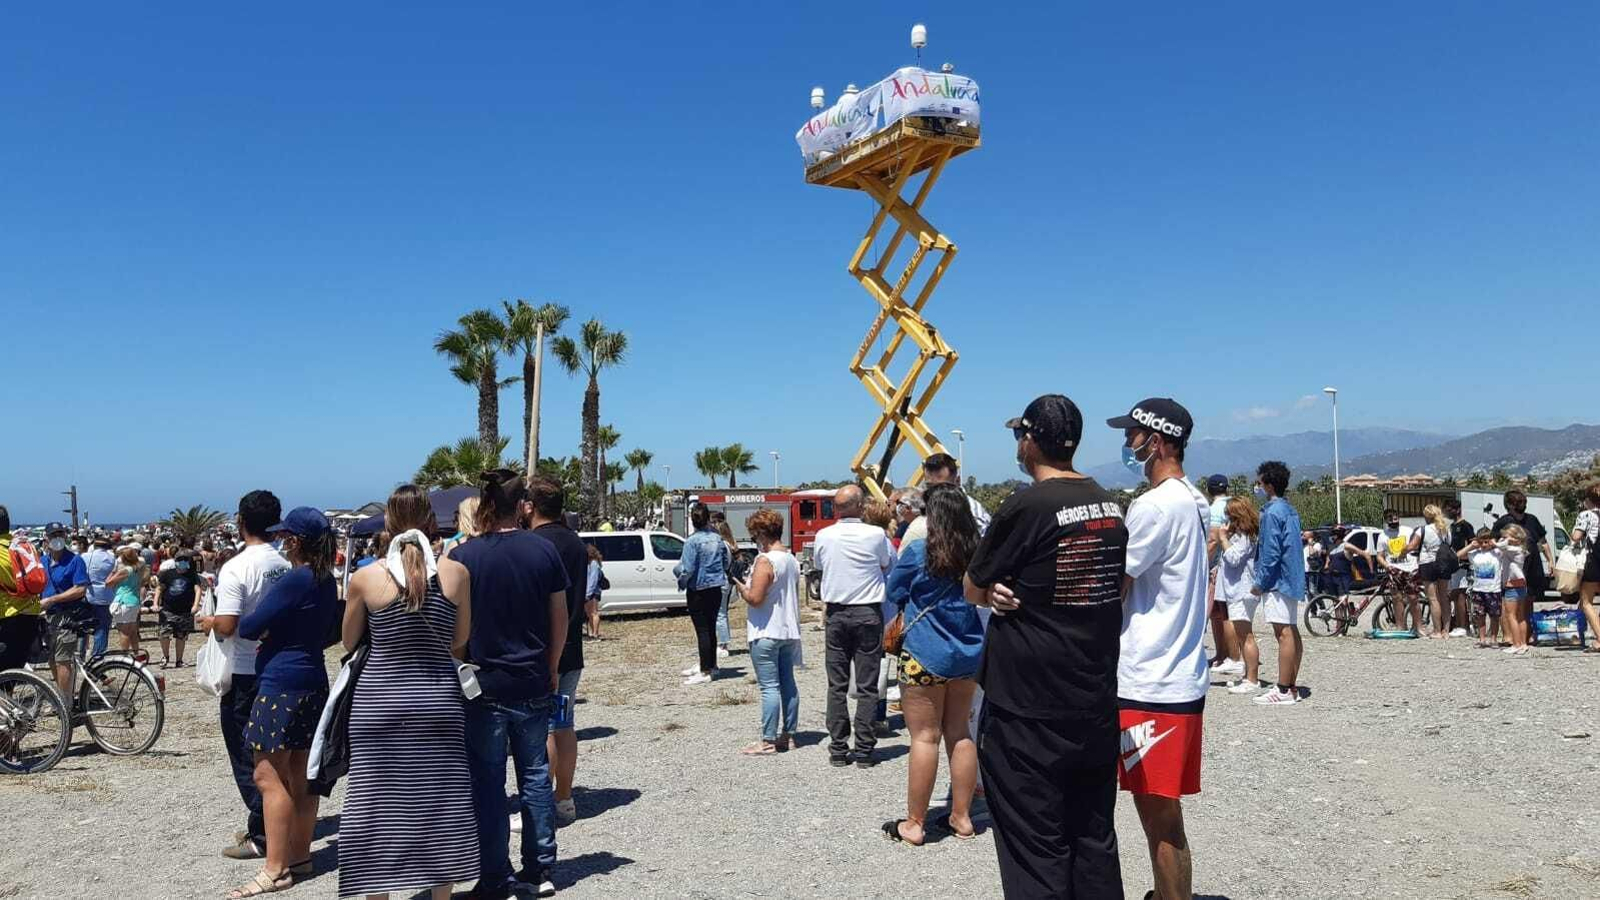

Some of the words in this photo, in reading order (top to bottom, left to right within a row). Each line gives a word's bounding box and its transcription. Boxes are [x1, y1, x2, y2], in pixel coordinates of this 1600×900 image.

[1132, 407, 1183, 437] adidas
[725, 494, 766, 503] BOMBEROS
[1056, 505, 1089, 526] HÉROES
[1088, 503, 1103, 519] DEL
[1084, 519, 1101, 530] TOUR
[1120, 719, 1156, 755] NIKE
